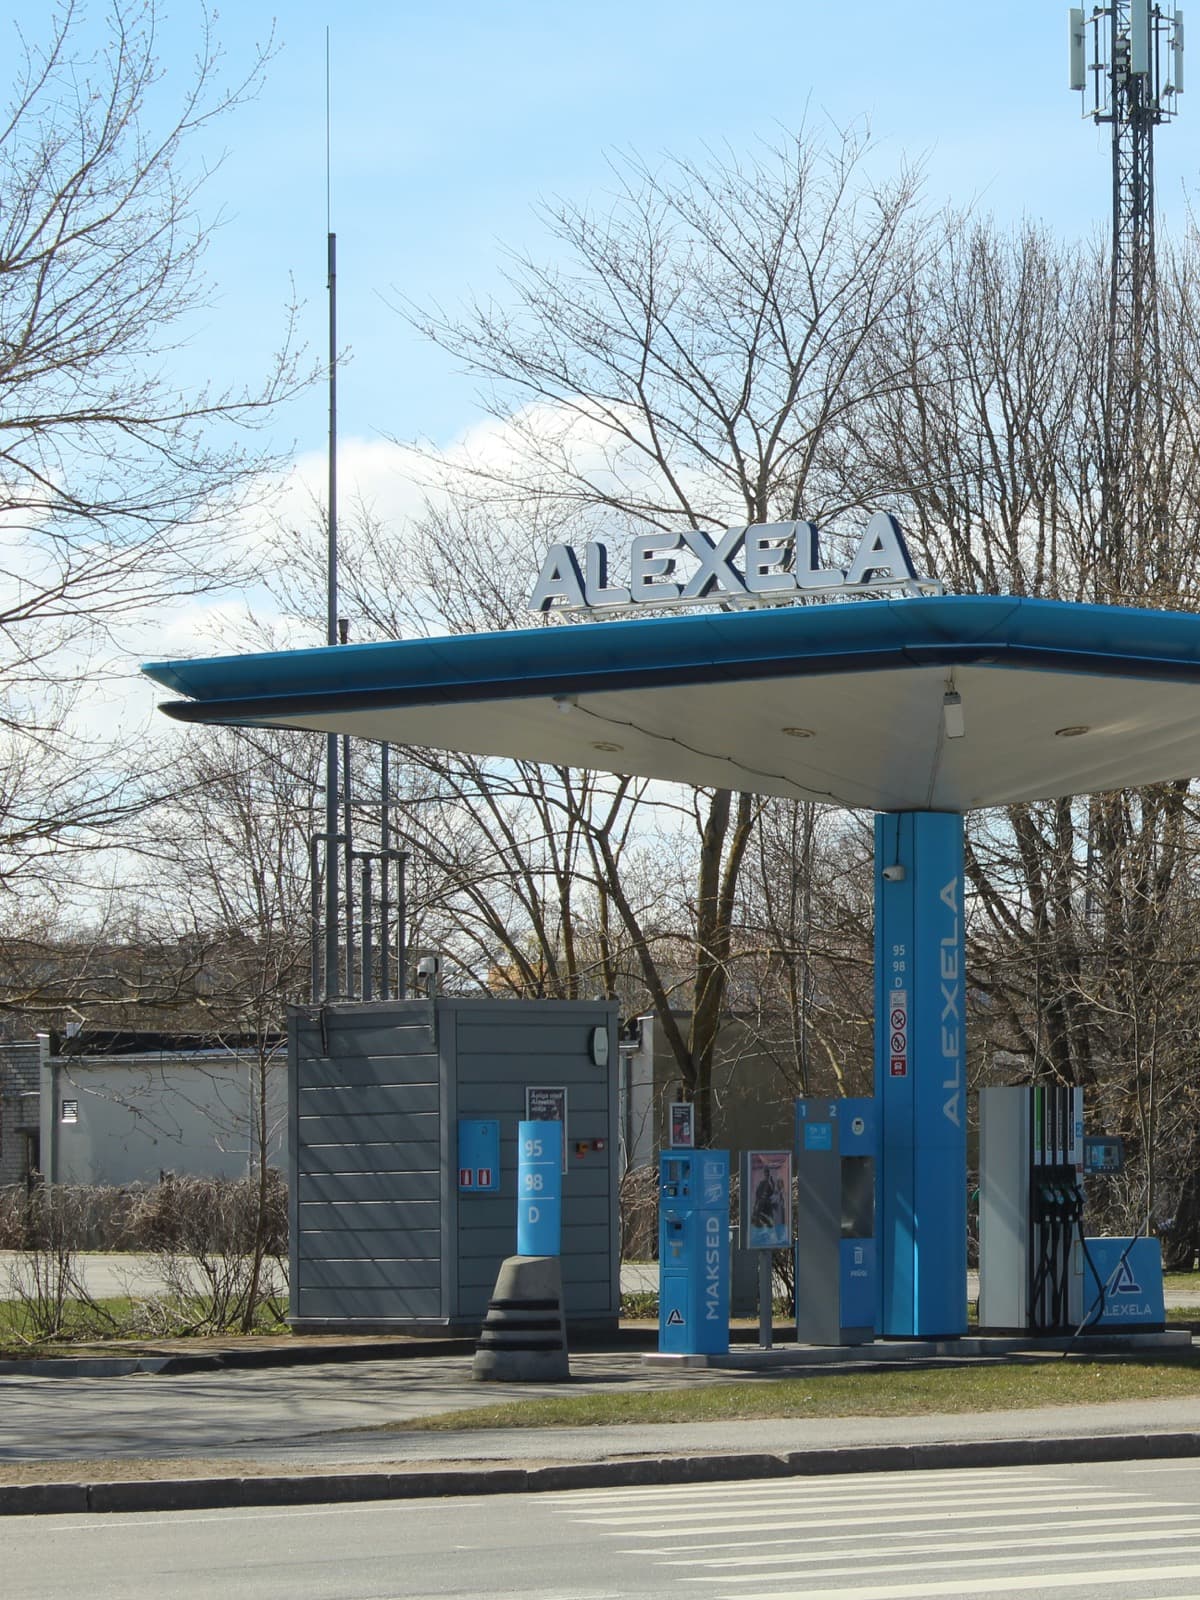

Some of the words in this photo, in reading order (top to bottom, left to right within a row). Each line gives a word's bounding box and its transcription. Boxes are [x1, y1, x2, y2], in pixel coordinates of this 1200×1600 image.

[528, 512, 919, 611] ALEXELA
[892, 944, 906, 956] 95
[892, 960, 906, 972] 98
[894, 976, 903, 988] D
[939, 876, 961, 1128] ALEXELA
[800, 1105, 807, 1117] 1
[829, 1105, 838, 1117] 2
[524, 1139, 543, 1157] 95
[525, 1173, 544, 1192] 98
[527, 1205, 540, 1224] D
[705, 1216, 720, 1321] MAKSED
[1103, 1303, 1153, 1317] LEXELA
